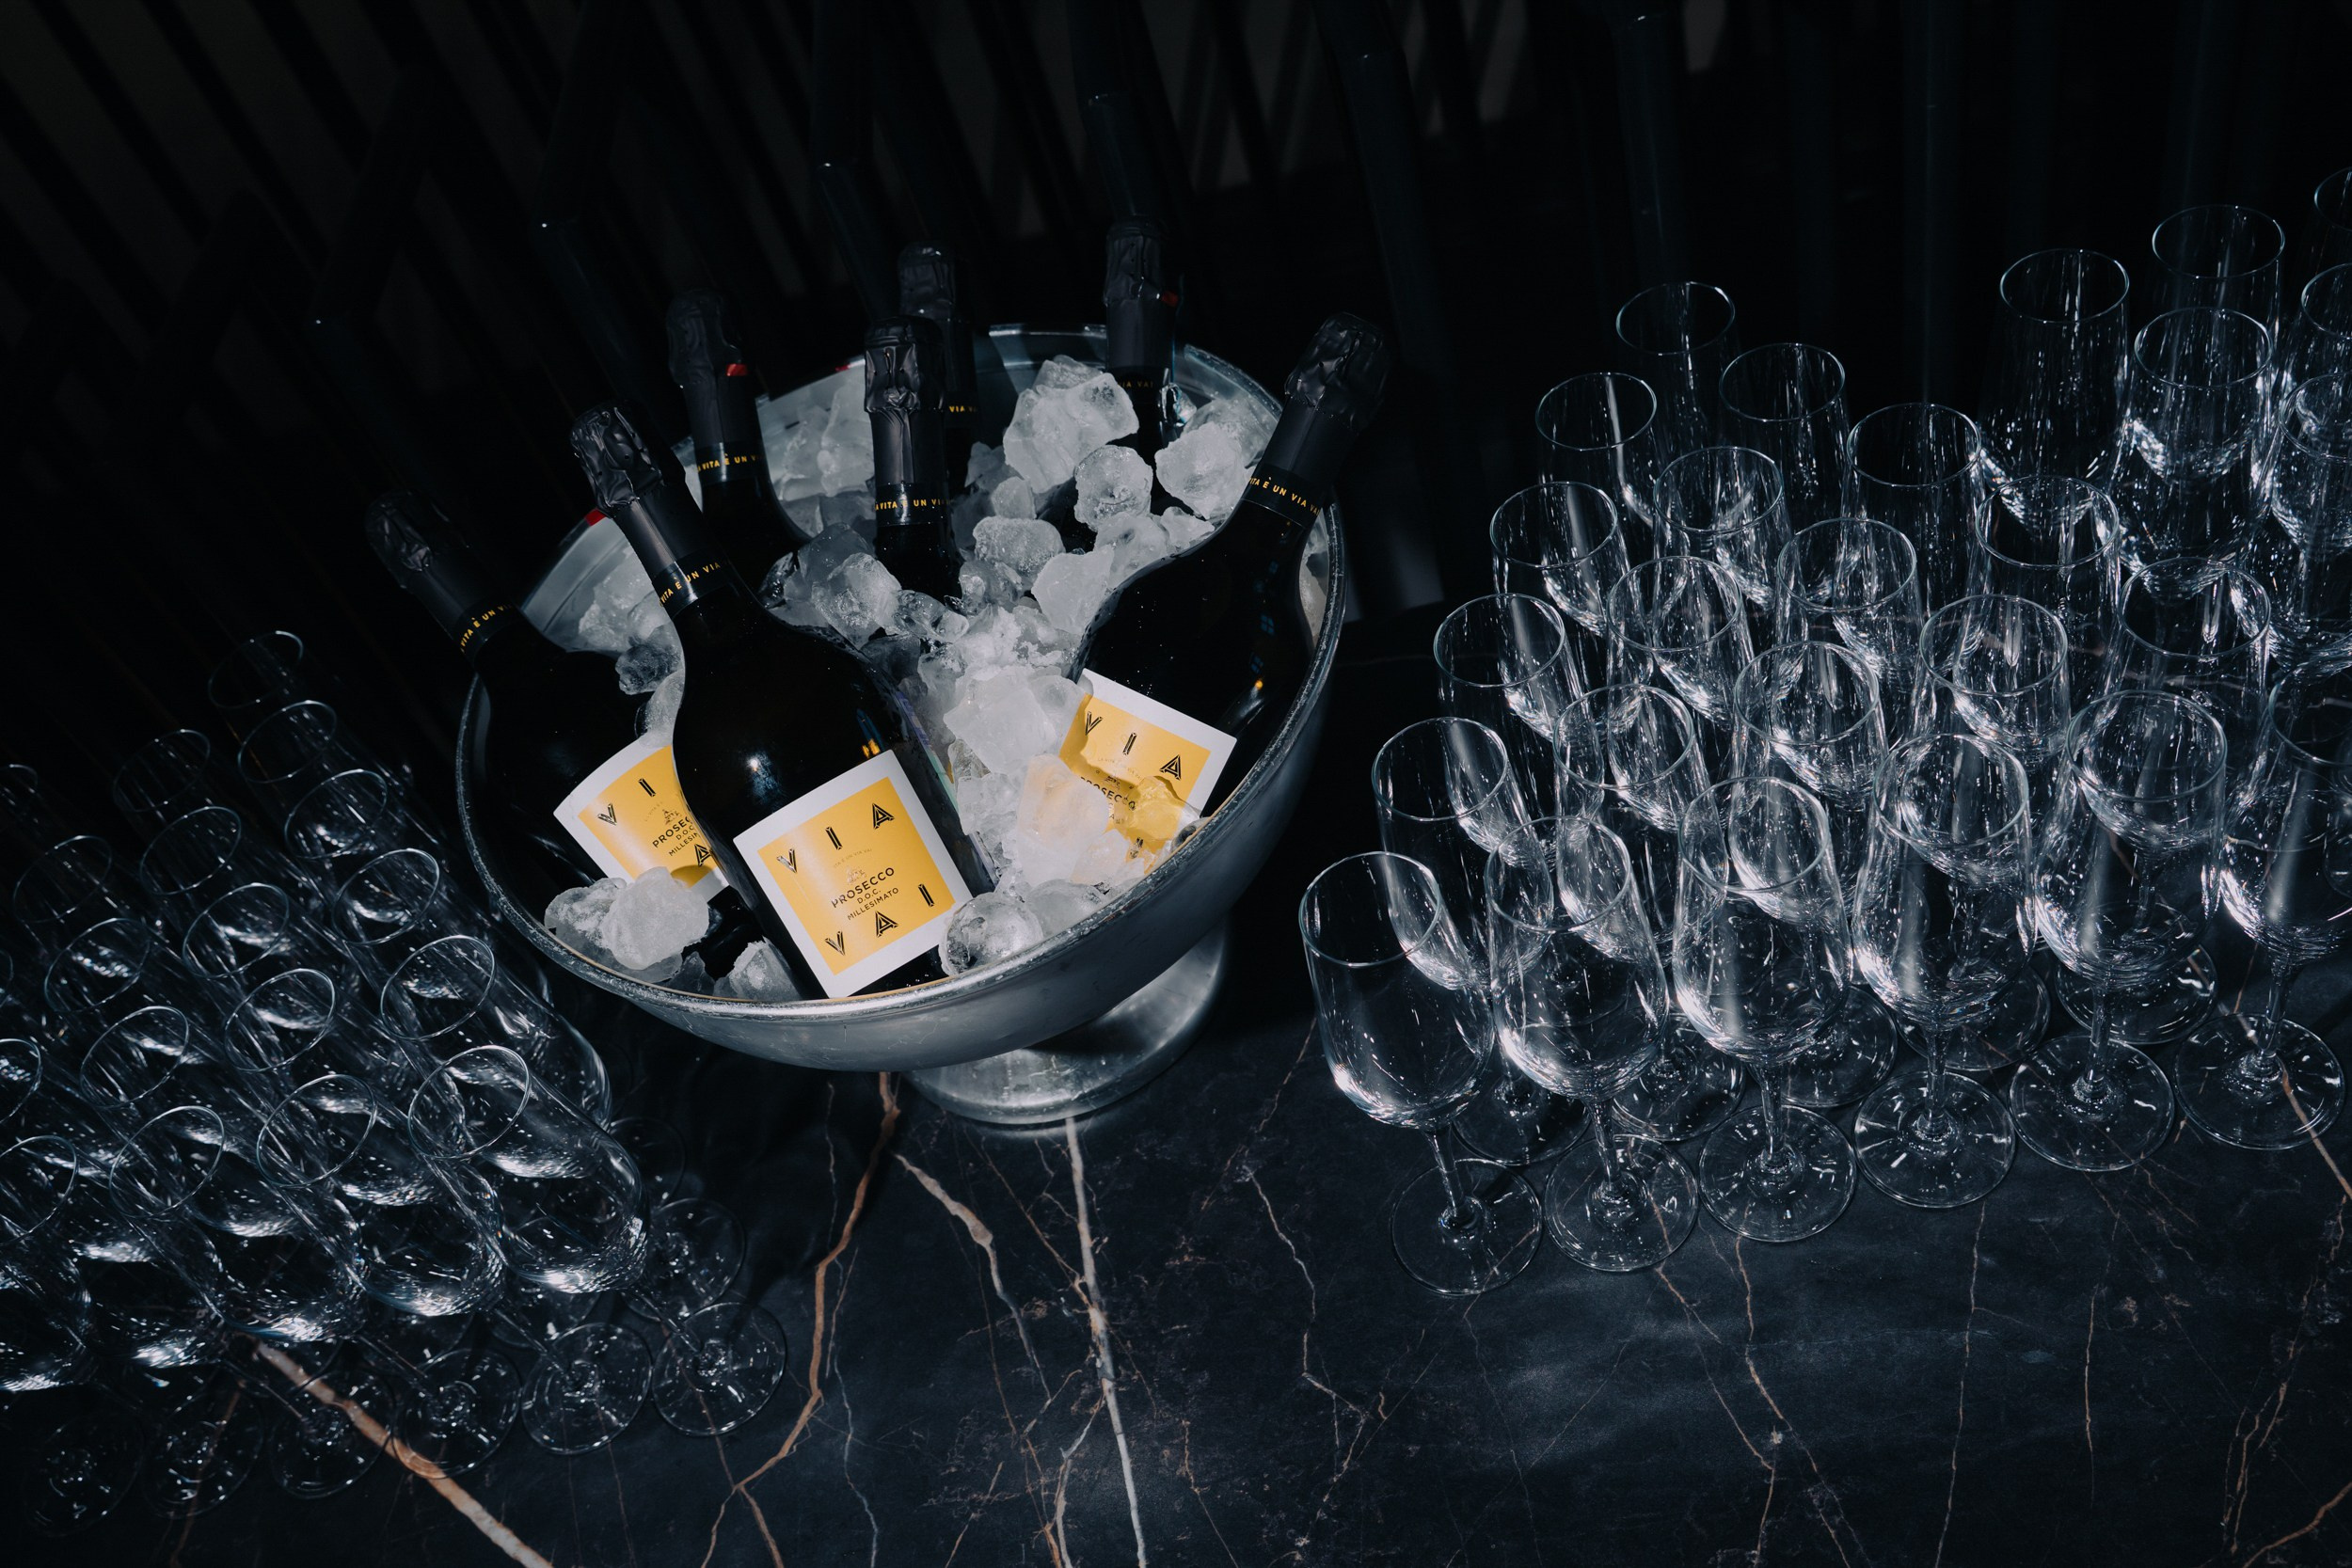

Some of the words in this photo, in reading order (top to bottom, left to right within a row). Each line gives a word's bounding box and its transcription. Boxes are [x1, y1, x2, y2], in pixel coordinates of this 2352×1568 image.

[702, 460, 721, 470] VITA
[734, 455, 748, 464] UN
[880, 500, 898, 510] VITA
[913, 499, 928, 507] UN
[1263, 476, 1272, 489] È
[1273, 484, 1287, 497] UN
[1291, 493, 1307, 508] VIA
[660, 588, 675, 604] VITA
[674, 577, 682, 590] È
[685, 570, 700, 583] UN
[703, 562, 722, 573] VIA
[460, 628, 474, 647] VITA
[482, 610, 496, 621] UN
[1085, 711, 1182, 781] VIA
[776, 803, 895, 874] VIA
[831, 867, 895, 909] PROSECCO
[847, 887, 899, 921] MILLESIMATO
[857, 889, 882, 905] D.O.C.
[825, 883, 936, 957] VAI
